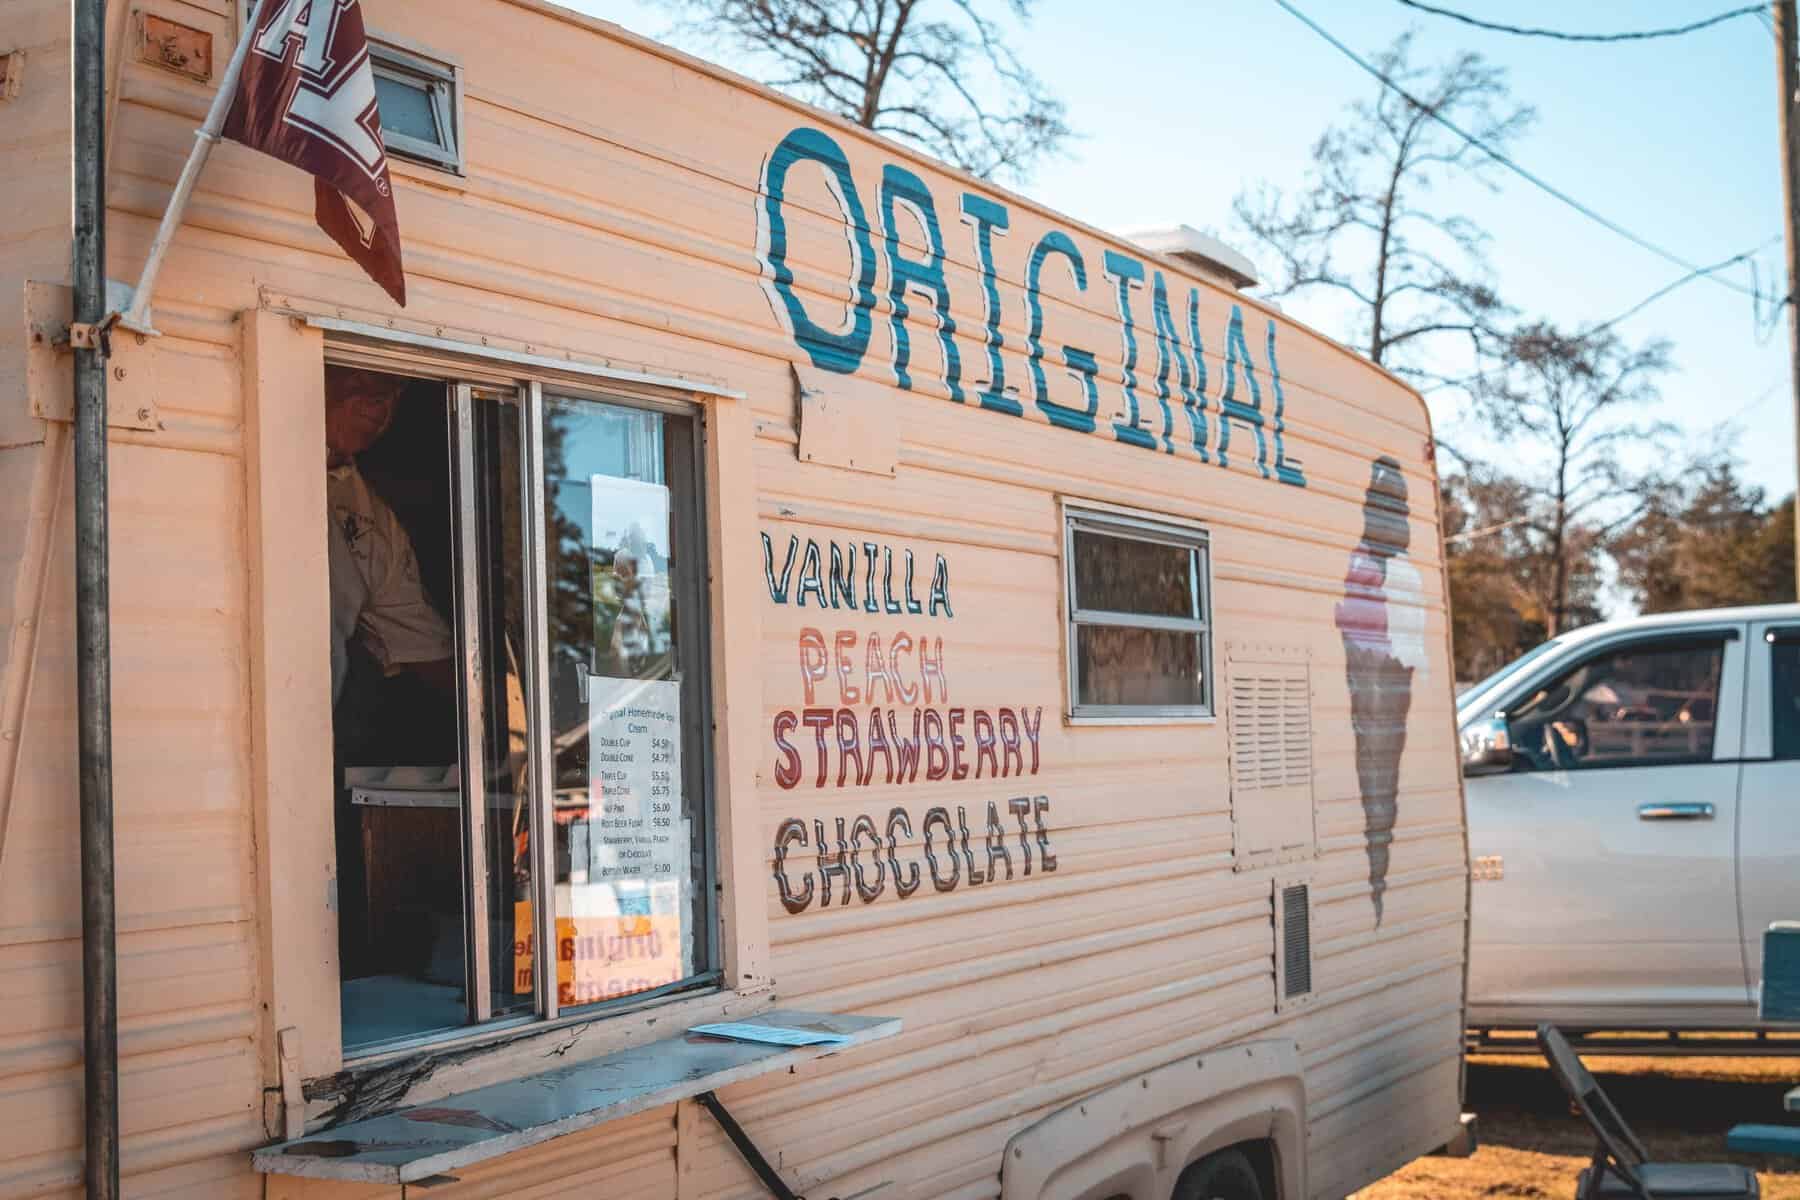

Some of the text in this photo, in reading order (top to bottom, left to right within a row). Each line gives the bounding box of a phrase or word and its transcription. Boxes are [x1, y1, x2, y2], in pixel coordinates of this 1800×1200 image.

[756, 126, 1307, 488] ORIGINAL
[760, 531, 954, 618] VANILLA
[799, 627, 948, 705] PEACH
[773, 706, 1046, 790] STRAWBERRY
[773, 795, 1058, 915] CHOCOLATE
